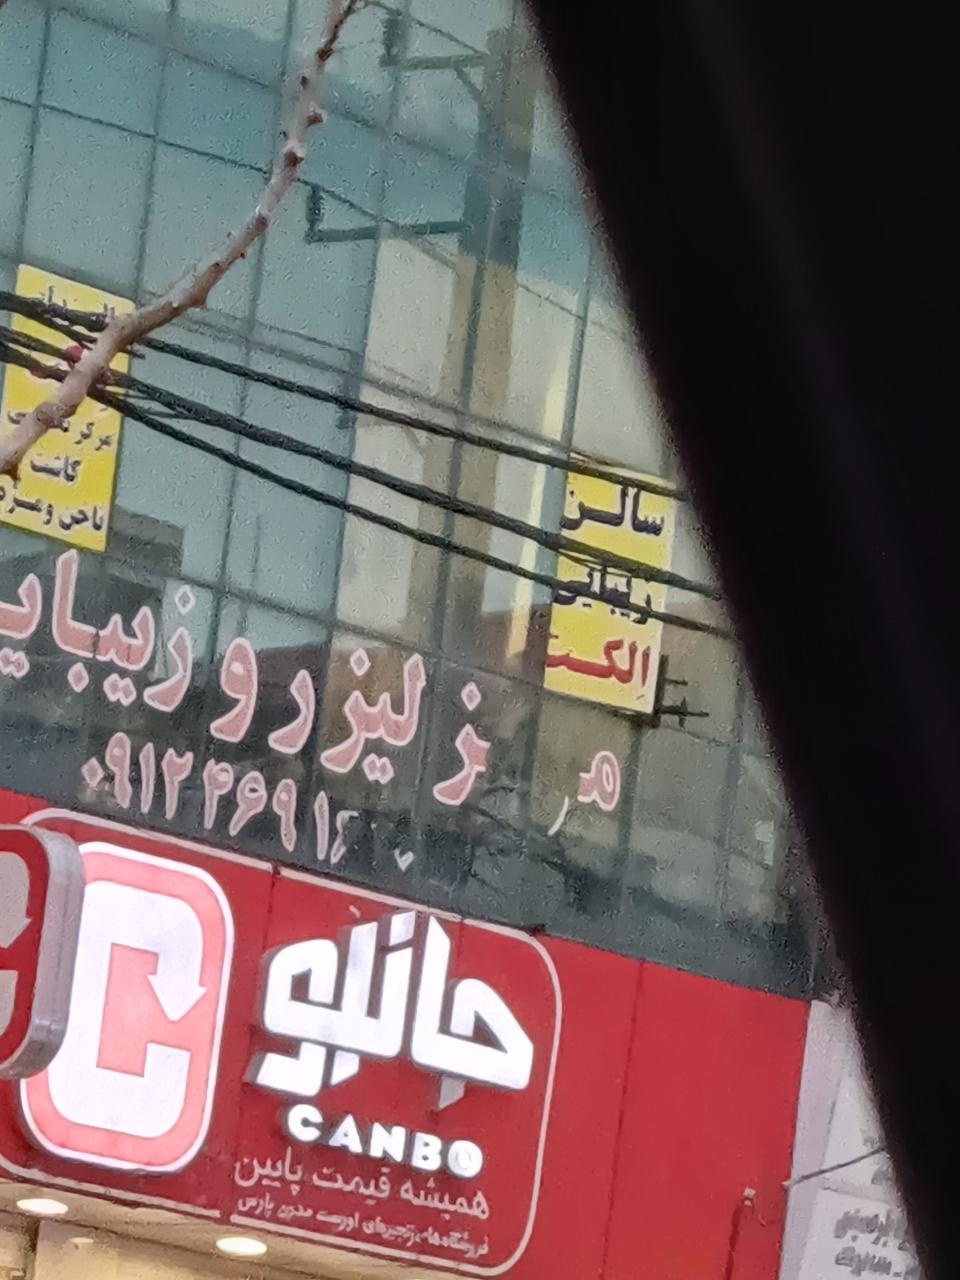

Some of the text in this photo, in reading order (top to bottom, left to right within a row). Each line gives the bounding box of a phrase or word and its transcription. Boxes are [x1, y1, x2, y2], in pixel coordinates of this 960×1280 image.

[210, 637, 258, 742] و
[268, 647, 427, 785] لیزر
[233, 1145, 491, 1221] همیشه قیمت پایین
[286, 1102, 485, 1180] CANBO
